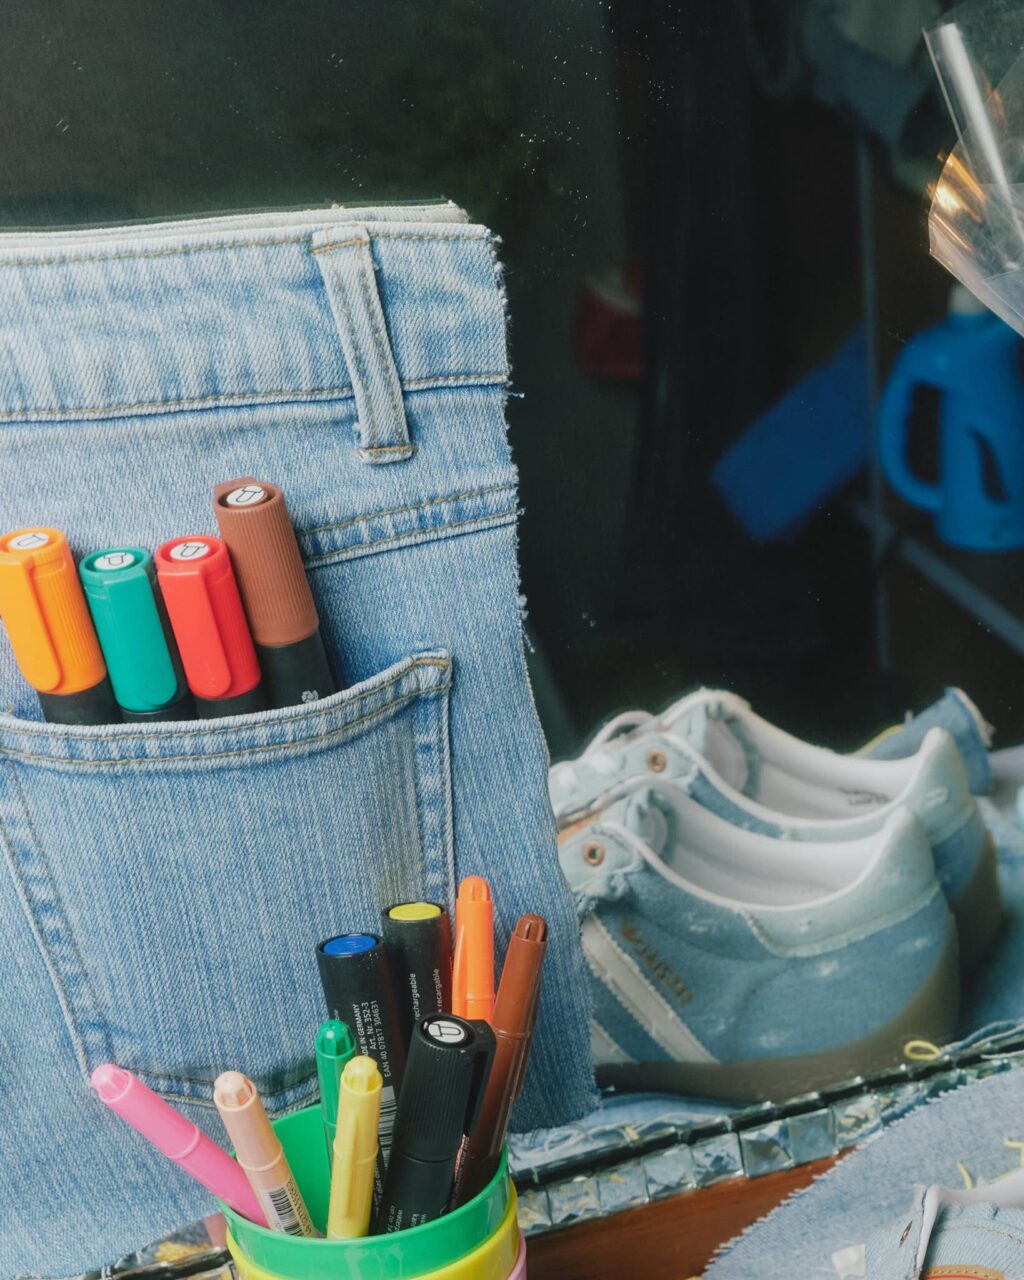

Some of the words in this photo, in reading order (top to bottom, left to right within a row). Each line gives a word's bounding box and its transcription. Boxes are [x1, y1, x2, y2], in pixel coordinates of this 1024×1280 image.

[409, 973, 421, 1020] rechargeable
[433, 968, 443, 1007] recargable
[352, 1003, 365, 1036] GERMANY
[361, 1002, 373, 1023] 352-3
[382, 1061, 392, 1078] EAN
